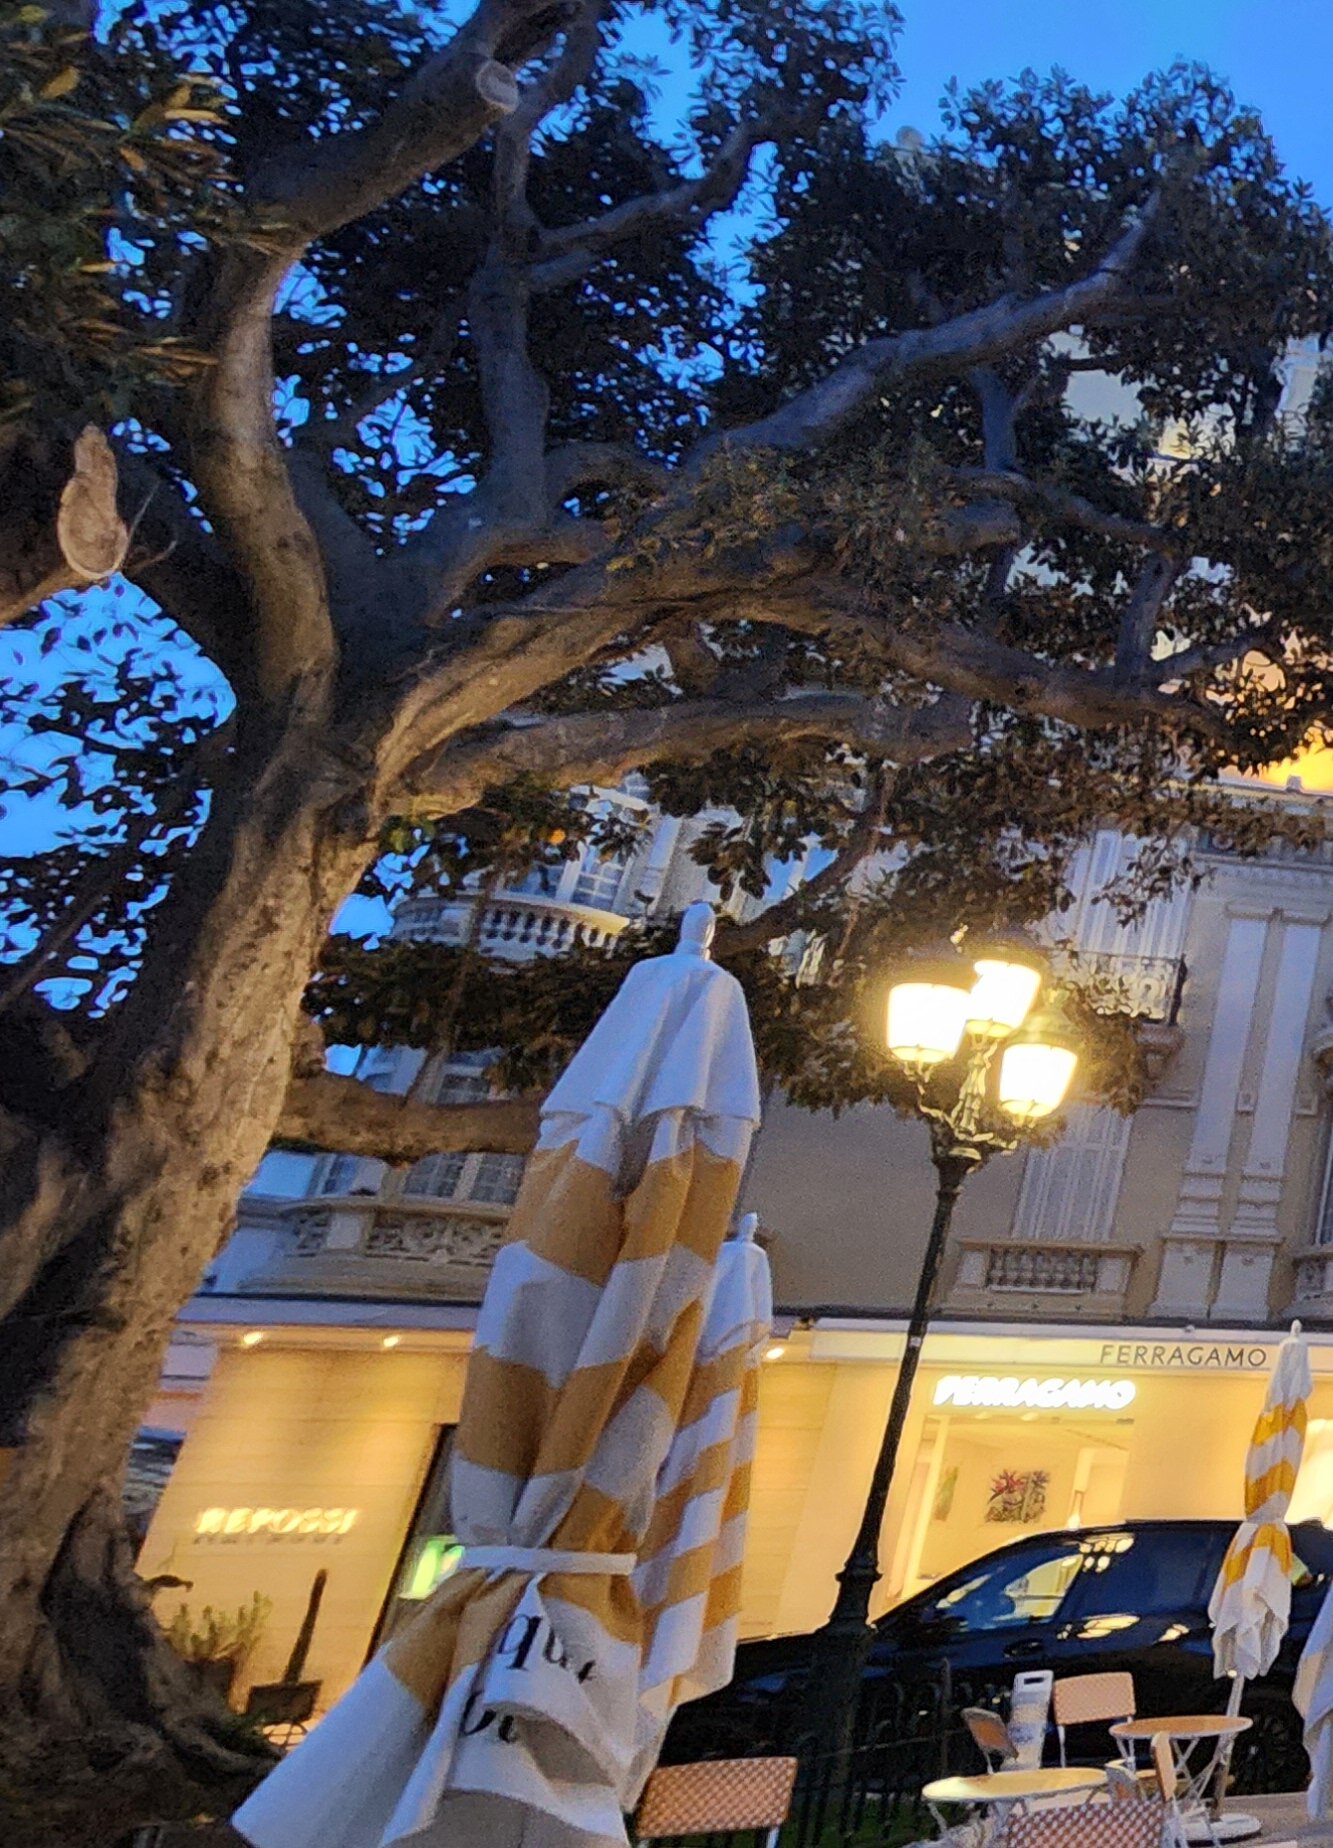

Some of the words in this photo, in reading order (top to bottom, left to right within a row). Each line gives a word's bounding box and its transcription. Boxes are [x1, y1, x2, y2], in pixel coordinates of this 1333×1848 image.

[1100, 1344, 1267, 1367] FERRAGAMO
[933, 1375, 1136, 1410] FERRAGAMO
[196, 1507, 358, 1534] REPOSSI
